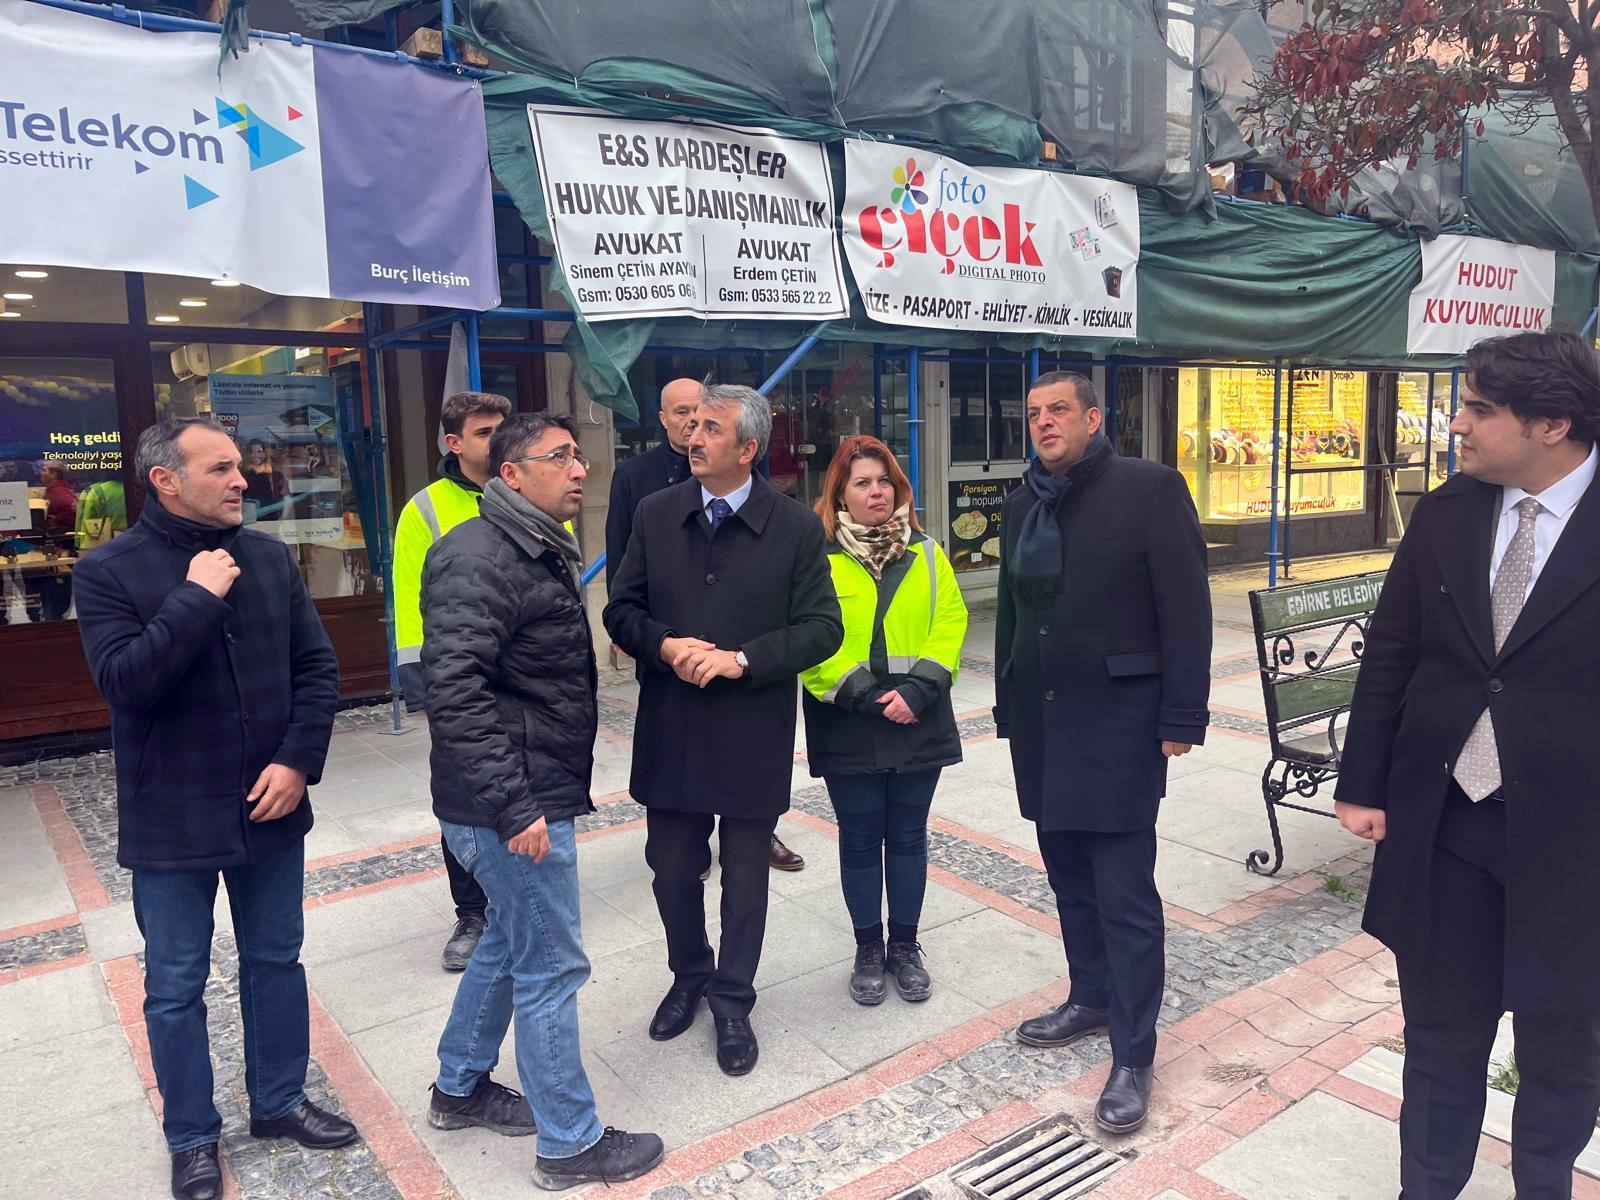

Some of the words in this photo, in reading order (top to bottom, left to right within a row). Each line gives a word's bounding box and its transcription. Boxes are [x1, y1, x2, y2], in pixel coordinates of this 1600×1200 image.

[0, 101, 224, 164] Telekom
[599, 133, 649, 168] E&S
[655, 136, 787, 182] KARDEŞLER
[935, 168, 986, 211] foto
[555, 183, 645, 215] HUKUK
[647, 185, 683, 215] VE
[685, 189, 827, 230] DANIŞMANLIK
[594, 232, 683, 255] AVUKAT
[737, 238, 811, 262] AVUKAT
[370, 263, 409, 284] Burç
[412, 264, 470, 289] İletişim
[570, 264, 614, 279] Sinem
[617, 260, 656, 281] ÇETİN
[733, 266, 777, 281] Erdem
[781, 267, 817, 285] ÇETİN
[959, 265, 1007, 280] DIGITAL
[1010, 269, 1046, 283] PHOTO
[1457, 261, 1518, 291] HUDUT
[578, 287, 612, 302] Gsm:
[615, 286, 648, 301] 0530
[651, 284, 675, 298] 605
[719, 287, 748, 302] Gsm:
[751, 288, 780, 302] 0533
[782, 289, 801, 303] 565
[802, 290, 816, 304] 22
[817, 291, 833, 304] 22
[903, 295, 972, 320] PASAPORT
[982, 299, 1027, 323] EHLİYET
[1034, 302, 1071, 326] KİMLİK
[1082, 306, 1133, 329] VESİKALIK
[1423, 298, 1546, 330] KUYUMCULUK
[50, 432, 81, 446] Hoş
[43, 451, 99, 460] Teknolojiyi
[963, 485, 998, 495] Porsiyon
[971, 496, 1003, 508] порция
[1286, 590, 1331, 617] EDİRNE
